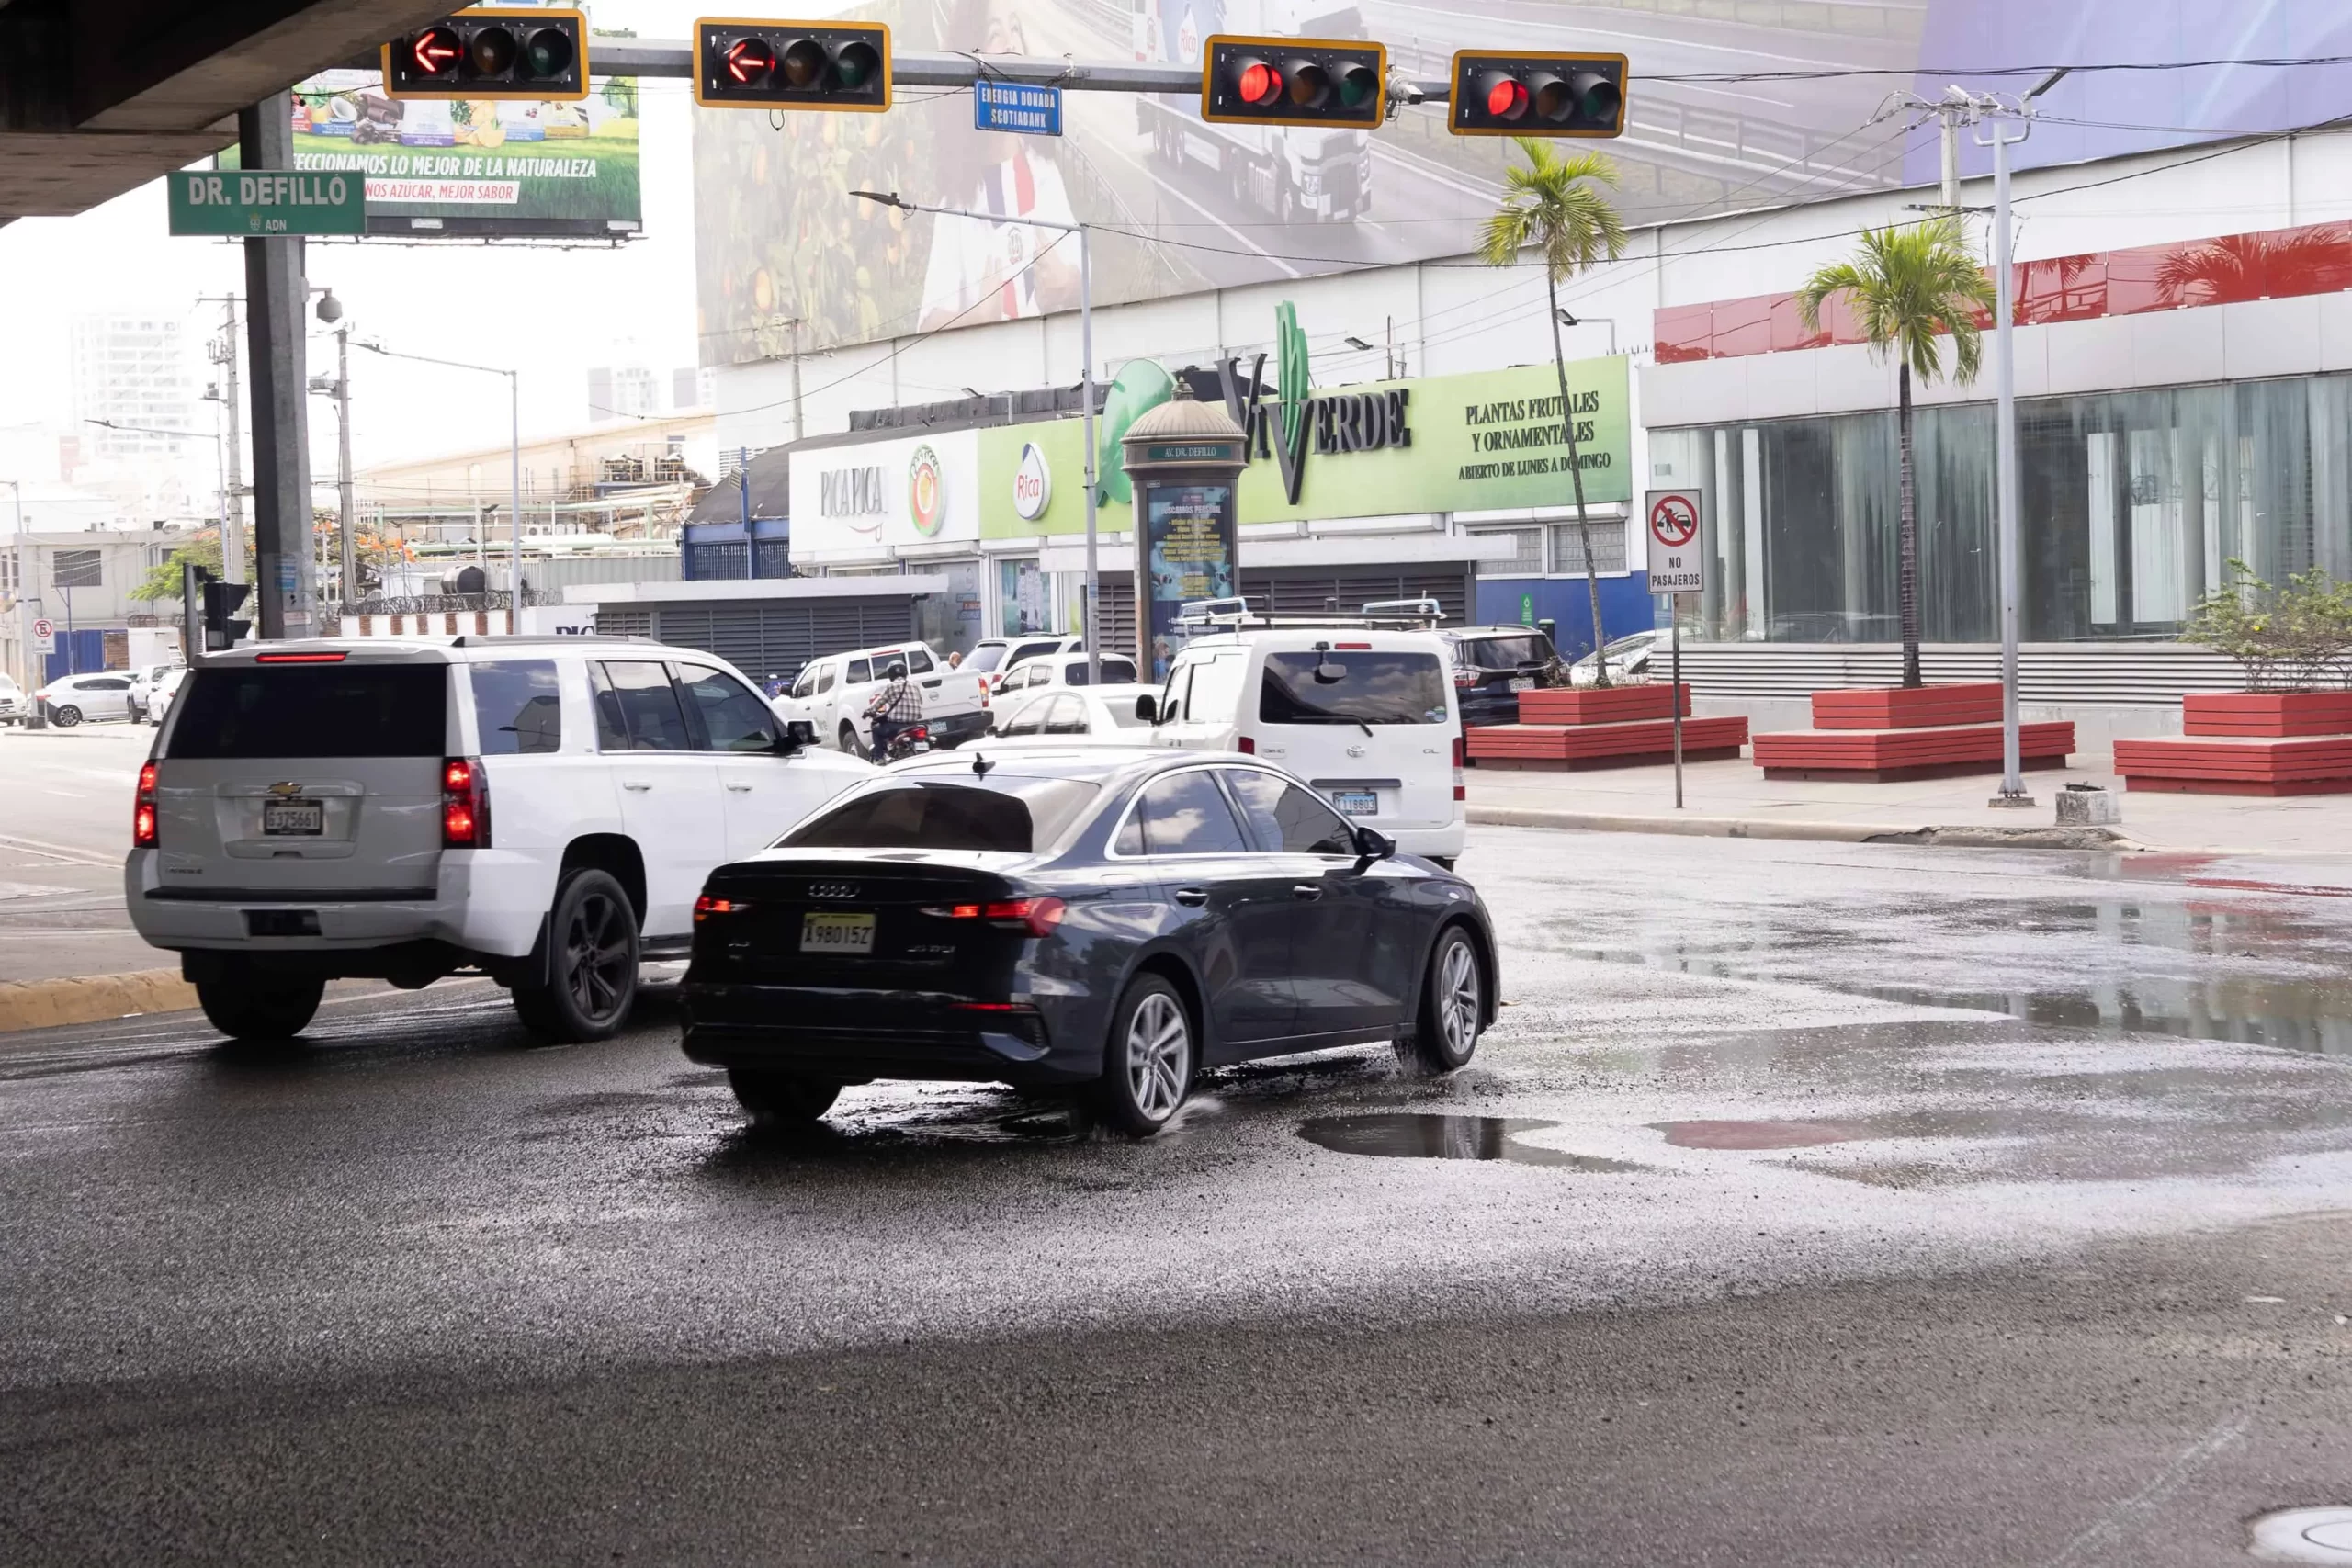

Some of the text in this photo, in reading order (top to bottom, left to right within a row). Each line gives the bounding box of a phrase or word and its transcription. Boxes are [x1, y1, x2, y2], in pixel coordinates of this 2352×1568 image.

[981, 87, 1056, 108] ENERGIA DONADA
[990, 108, 1046, 128] SCOTIABANK
[390, 155, 409, 175] LO
[412, 156, 461, 175] MEJOR
[463, 157, 483, 176] DE
[486, 157, 503, 176] LA
[506, 157, 597, 178] NATURALEZA
[189, 176, 232, 205] DR.
[390, 181, 435, 199] AZÚCAR,
[439, 185, 474, 199] MEJOR
[478, 186, 513, 199] SABOR
[265, 220, 287, 231] ADN
[1465, 390, 1599, 425] PLANTAS FRUTLES
[1175, 447, 1187, 457] DR.
[1472, 433, 1481, 452] Y
[1458, 462, 1500, 480] ABIERTO
[1501, 461, 1515, 477] DE
[1517, 458, 1549, 476] LUNES
[1551, 457, 1558, 472] A
[1017, 474, 1039, 501] Rica
[1668, 557, 1681, 569] NO
[1652, 573, 1700, 587] PASAJEROS
